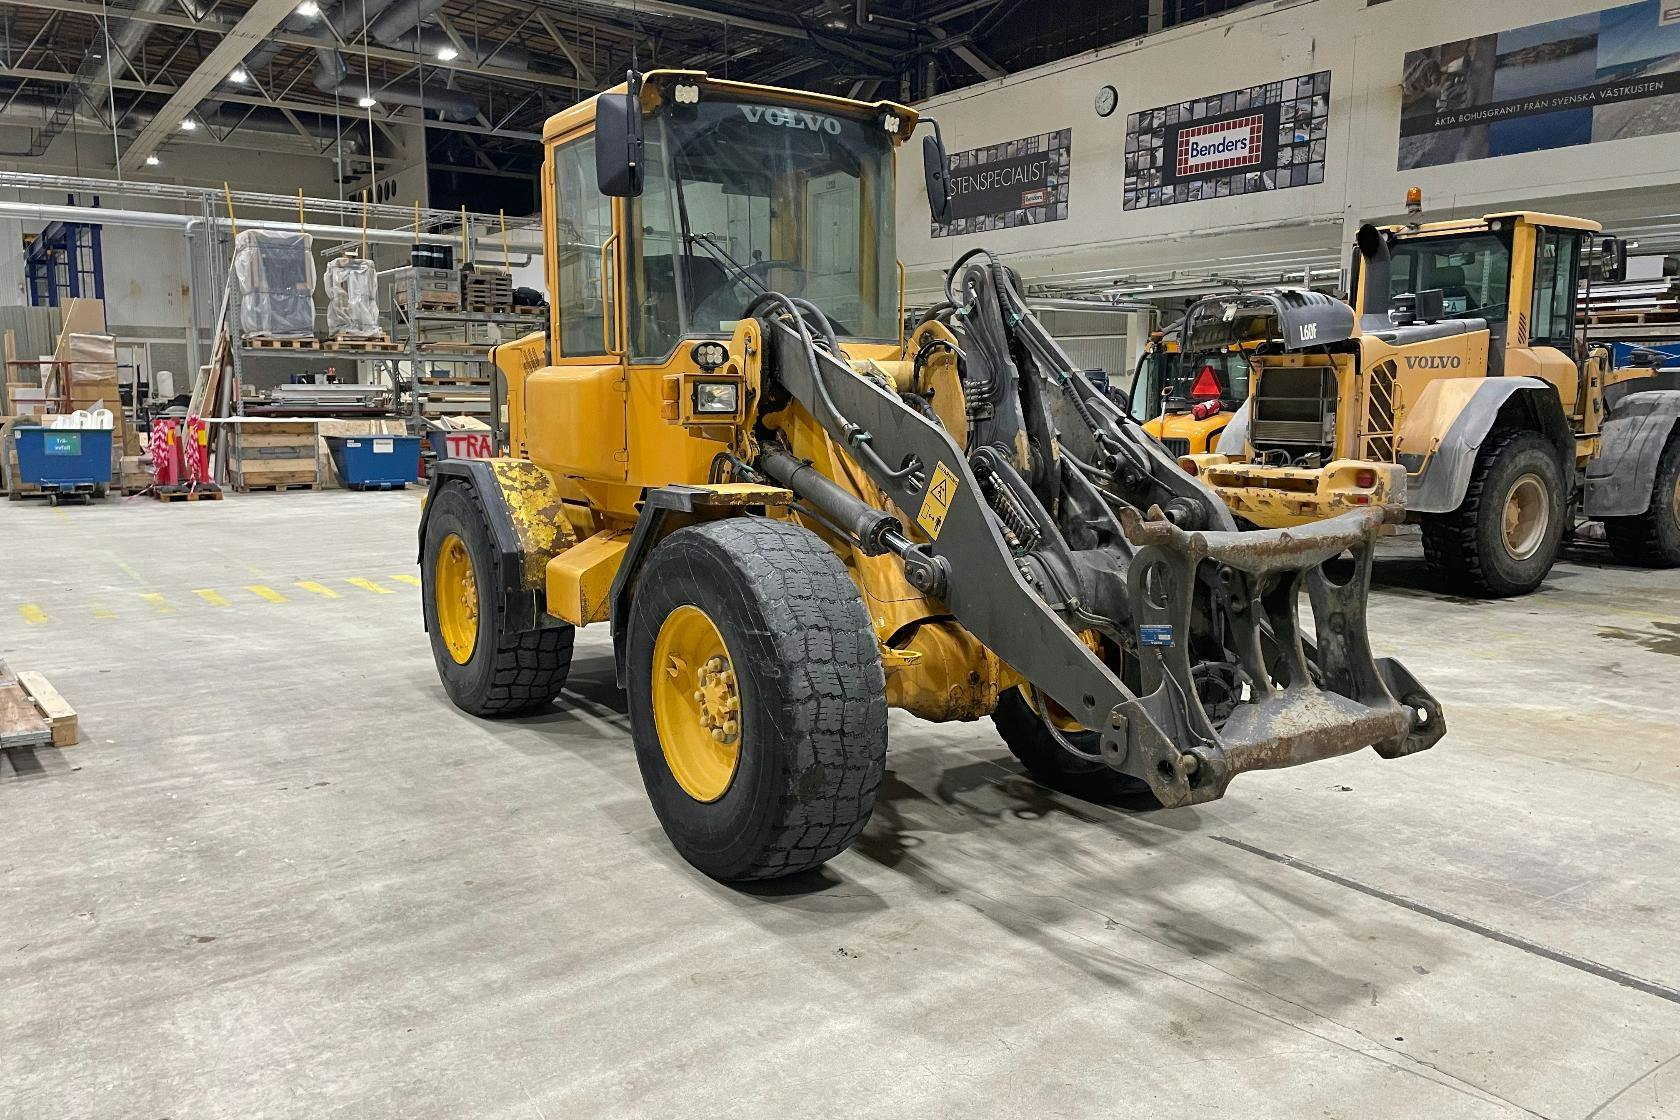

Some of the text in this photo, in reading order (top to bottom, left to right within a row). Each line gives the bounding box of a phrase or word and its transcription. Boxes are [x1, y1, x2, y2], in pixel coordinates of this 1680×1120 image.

[1435, 81, 1664, 126] ÄKTA BOHUSGRANIT FRÅN SVENSKA VÄSTKUSTEN
[737, 104, 842, 135] VOLVO
[1191, 136, 1248, 158] Benders
[950, 161, 1047, 195] STENSPECIALIST
[1300, 322, 1317, 341] L60F
[1405, 355, 1461, 370] VOLVO
